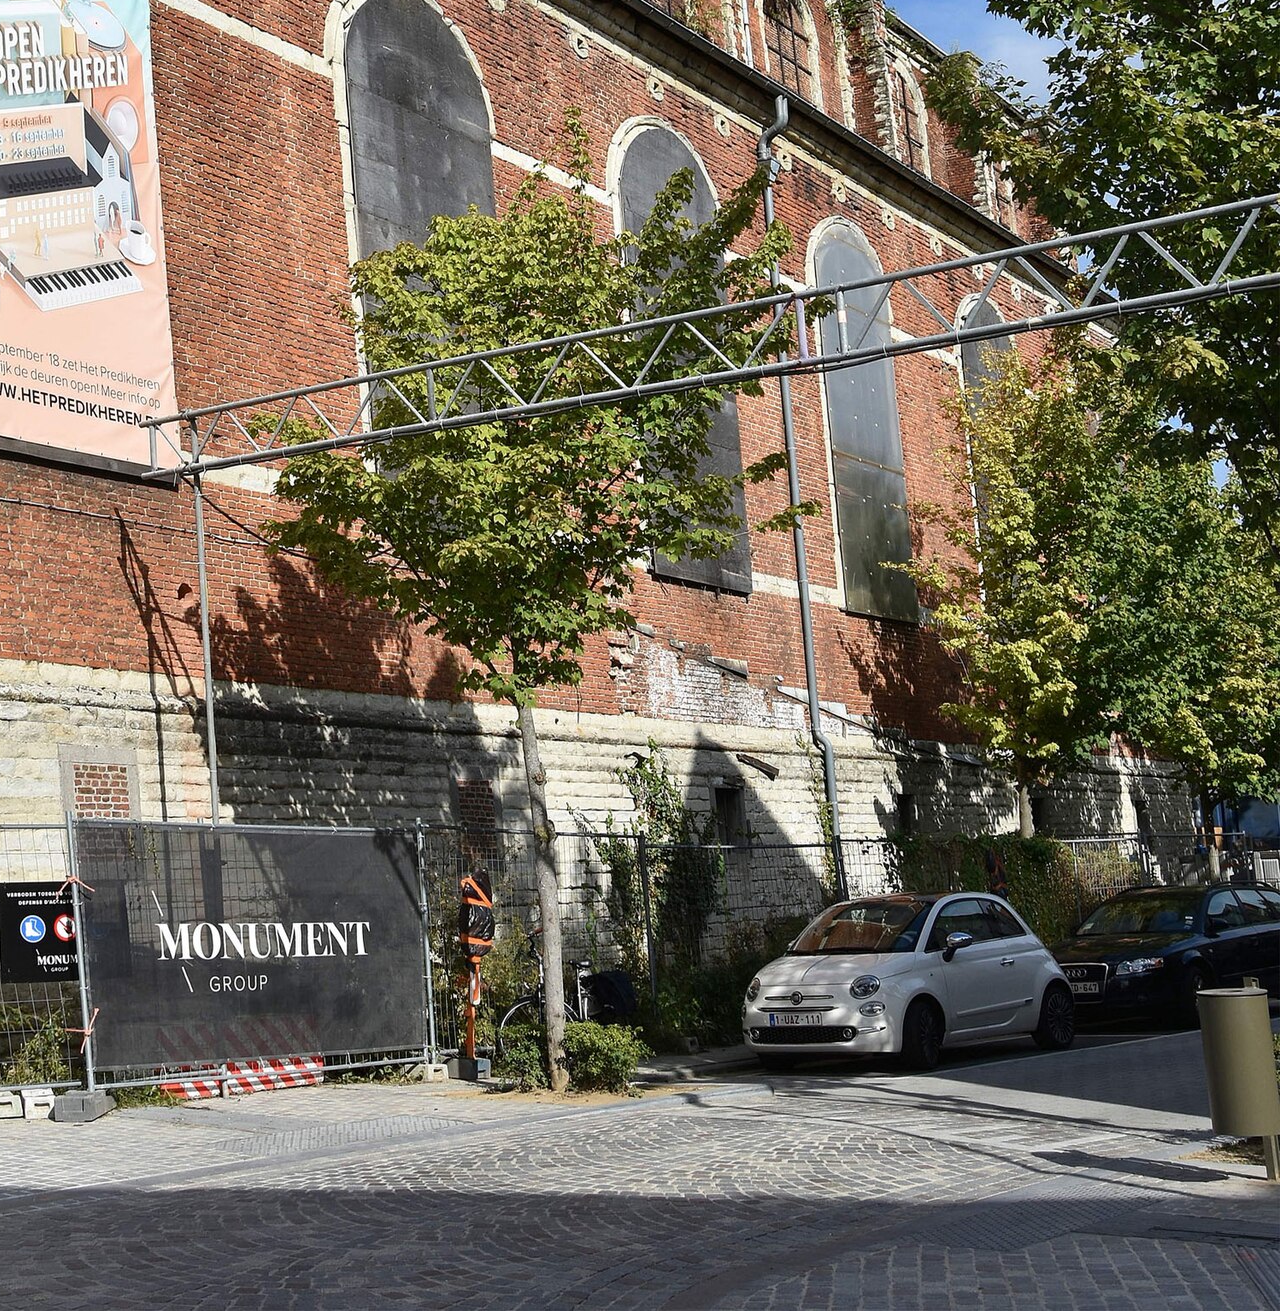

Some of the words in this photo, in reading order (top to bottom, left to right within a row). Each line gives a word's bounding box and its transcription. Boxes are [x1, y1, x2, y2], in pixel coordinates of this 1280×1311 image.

[24, 128, 65, 144] september
[25, 145, 66, 160] september
[62, 358, 79, 372] zet
[80, 361, 99, 377] Het
[100, 365, 161, 391] Predikheren
[14, 364, 29, 379] de
[30, 368, 69, 388] deuren
[70, 378, 100, 395] open!
[101, 384, 127, 402] Meer
[128, 390, 148, 406] info
[148, 397, 161, 410] op
[154, 921, 371, 961] MONUMENT
[209, 974, 268, 992] GROUP
[775, 1014, 821, 1025] 1-UAZ-111
